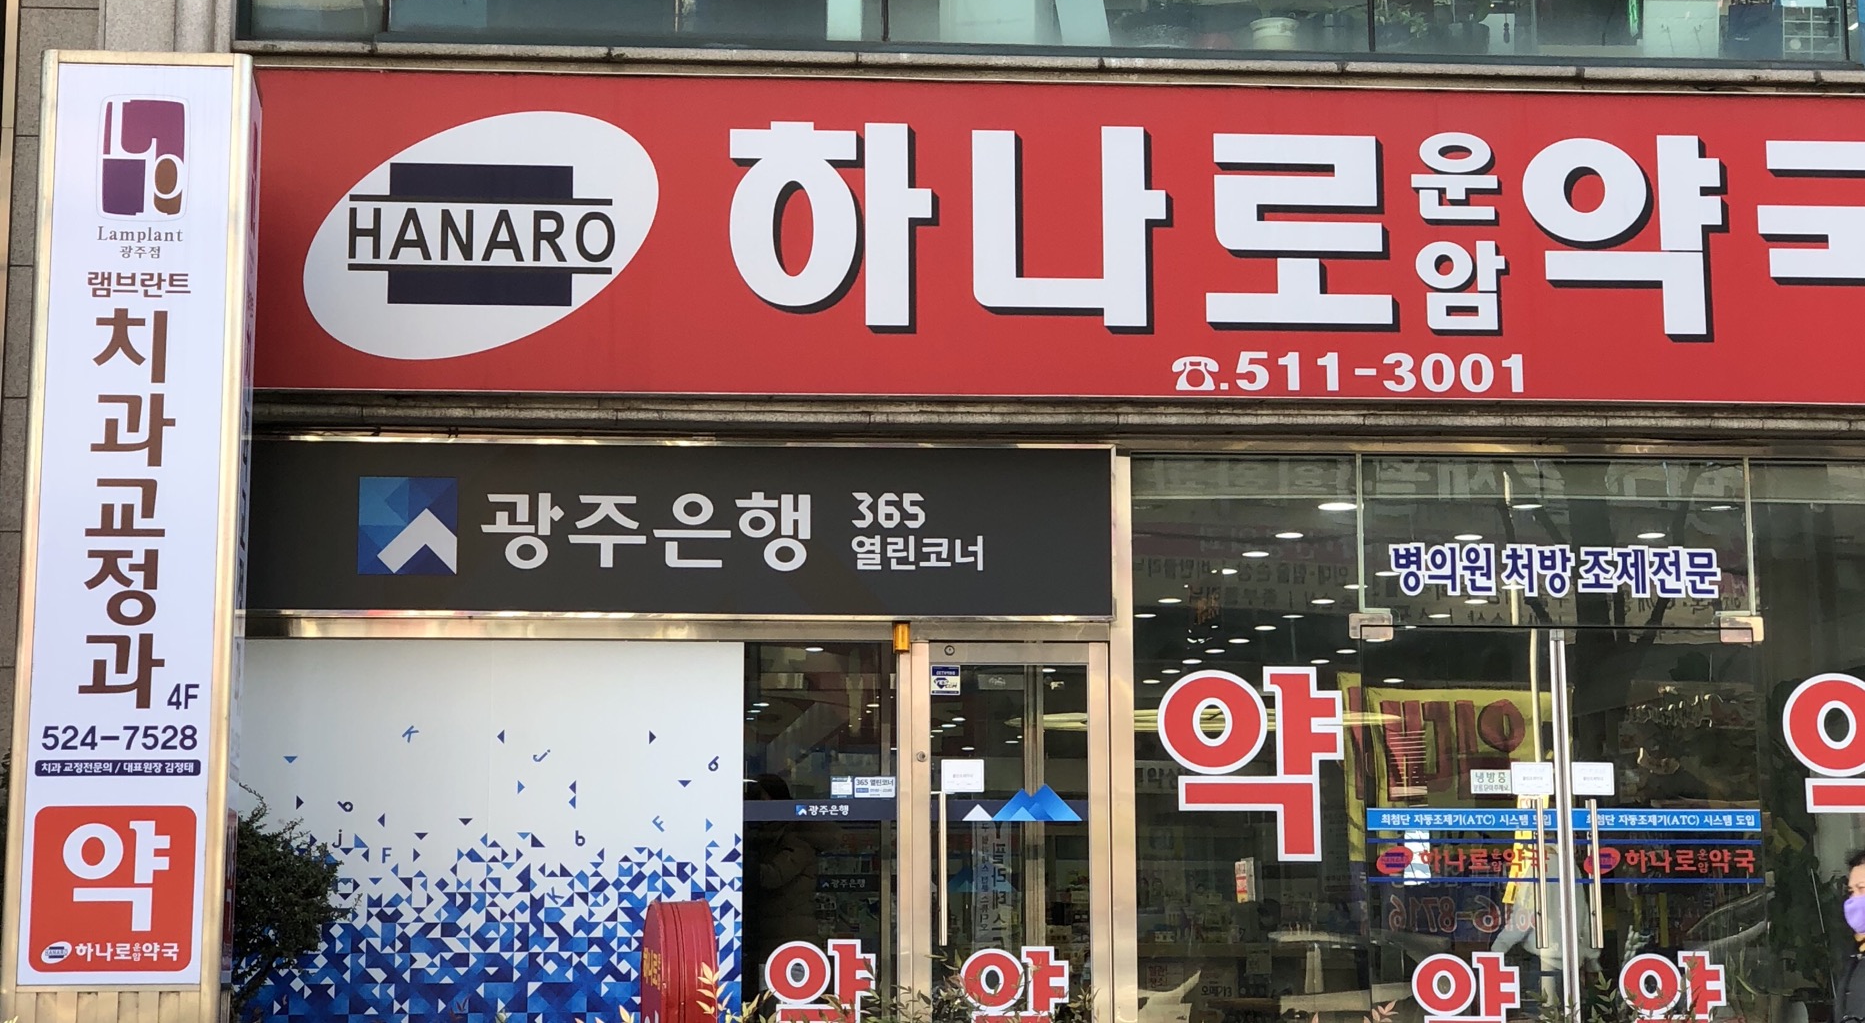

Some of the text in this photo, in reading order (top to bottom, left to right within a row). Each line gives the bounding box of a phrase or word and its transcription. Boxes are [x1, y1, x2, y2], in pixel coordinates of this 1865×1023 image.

[97, 226, 183, 244] Lamplant
[347, 206, 616, 263] HANARO
[728, 121, 1398, 331] 하나로
[119, 245, 161, 259] 광주점
[88, 271, 191, 298] 램브란트
[850, 492, 925, 530] 365
[480, 492, 811, 572] 광주은행
[850, 534, 985, 571] 열린코너
[1389, 542, 1721, 599] 병의원 처방 조제전문
[167, 683, 200, 710] 4F
[41, 725, 198, 751] 524-7528
[41, 762, 61, 774] 치과
[63, 762, 112, 774] 교정전문의
[123, 762, 163, 774] 대표원장
[164, 762, 194, 774] 김정태
[1157, 666, 1344, 862] 약
[808, 805, 849, 816] 광주은행
[1381, 814, 1411, 826] 최첨단
[1414, 814, 1496, 826] 자동조제기(ATC)
[1499, 814, 1529, 826] 시스템
[1618, 814, 1700, 826] 자동조제기(ATC)
[1703, 815, 1733, 826] 시스템
[1735, 815, 1756, 826] 도입
[1625, 849, 1697, 874] 하나로
[1709, 849, 1756, 874] 약국
[63, 820, 171, 931] 약
[75, 942, 132, 962] 하나로
[142, 942, 180, 962] 약국
